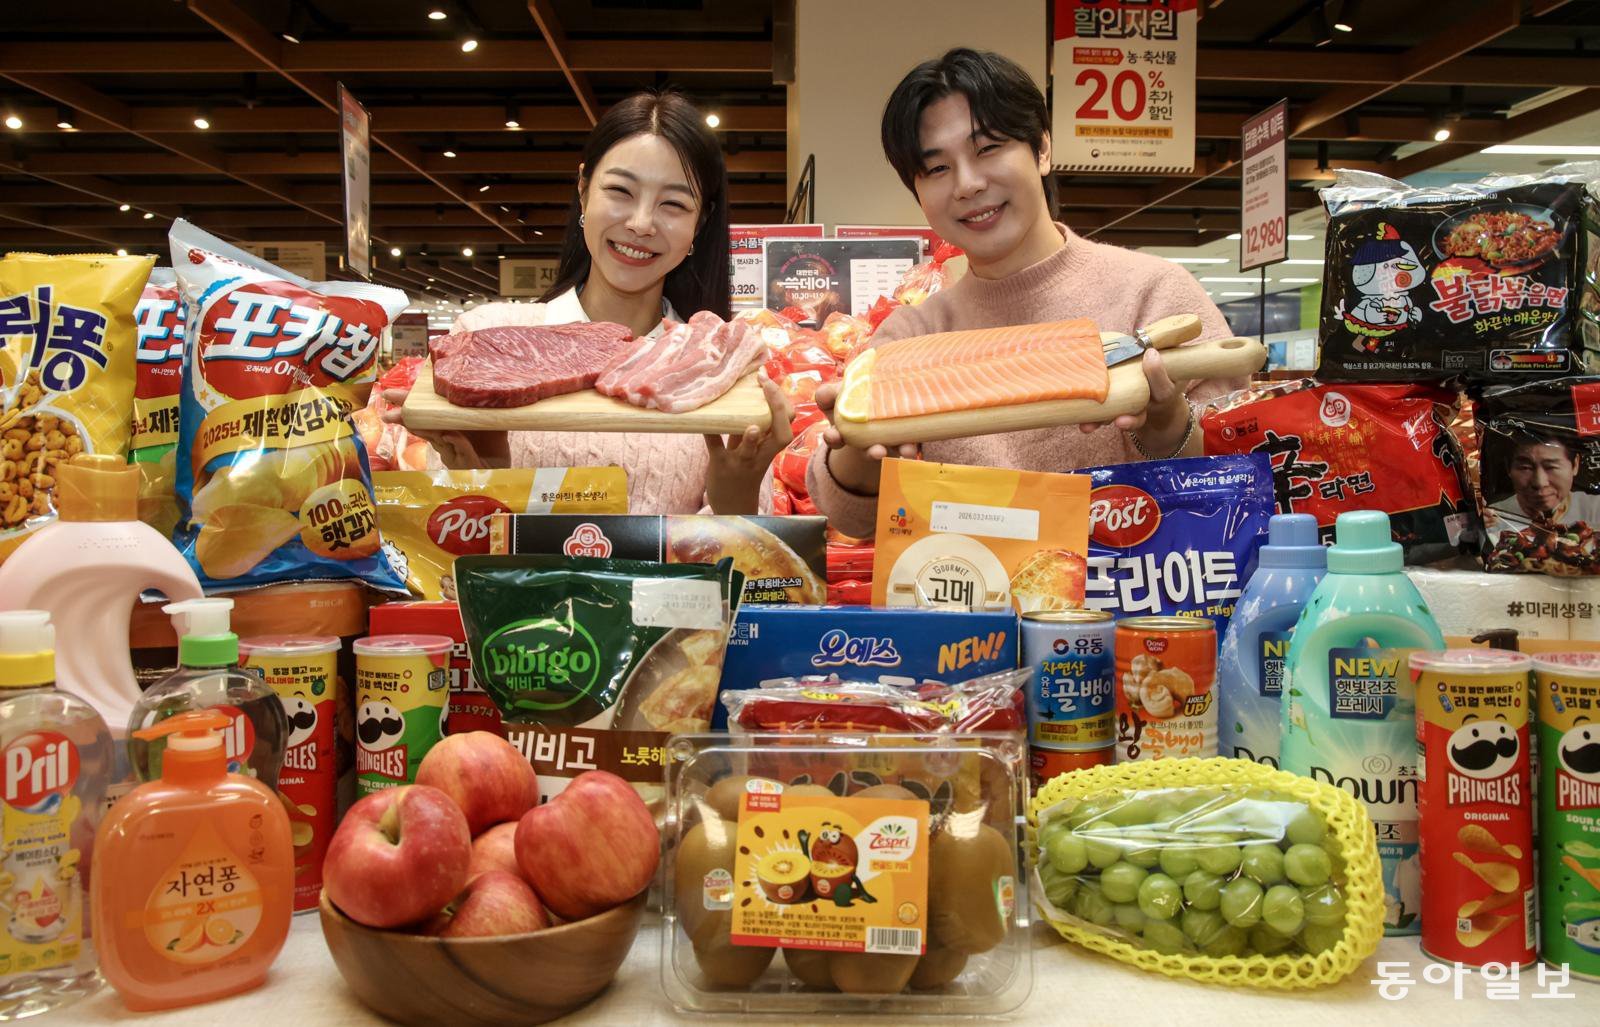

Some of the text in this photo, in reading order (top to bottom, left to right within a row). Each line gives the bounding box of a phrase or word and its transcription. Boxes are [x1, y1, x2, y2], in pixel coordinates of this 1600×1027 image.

[1073, 7, 1177, 40] 할인지원
[1127, 50, 1177, 65] 농·축산물
[1148, 90, 1173, 105] 추가
[1148, 105, 1173, 121] 할인
[1245, 216, 1285, 255] 12,980
[1430, 274, 1569, 322] 불닭볶음면
[1473, 312, 1558, 334] 화끈한 매운맛!
[203, 290, 380, 383] 포카칩
[273, 359, 316, 386] Original
[202, 419, 241, 449] 2025년
[1318, 471, 1376, 500] 라면
[306, 490, 368, 527] 100% 국산
[1089, 497, 1147, 536] Post
[320, 507, 377, 551] 햇감자
[932, 563, 970, 577] GOURMET
[927, 576, 974, 606] 고메
[1176, 609, 1204, 617] Corn
[1507, 601, 1593, 618] #미래생활
[812, 629, 901, 667] 오예스
[938, 632, 1006, 674] NEW!
[1074, 638, 1104, 655] 유동
[490, 642, 591, 683] bibigo
[1042, 661, 1086, 677] 자연산
[1335, 658, 1400, 677] NEW
[505, 676, 546, 691] 비비고
[1336, 680, 1397, 696] 햇빛건조
[1051, 677, 1116, 713] 골뱅이
[1336, 698, 1383, 713] 프레시
[1454, 695, 1512, 708] 리얼 액션!
[1565, 697, 1591, 709] 리얼
[464, 705, 494, 718] 1974
[1183, 703, 1204, 717] UP
[1118, 711, 1148, 760] 왕
[356, 747, 404, 778] PRINGLES
[620, 747, 675, 766] 노릇해
[6, 740, 69, 800] Pril
[1448, 773, 1520, 806] PRINGLES
[1559, 774, 1600, 807] PRIN
[1464, 812, 1510, 821] ORIGINAL
[1566, 814, 1594, 824] SOUR
[869, 832, 911, 850] Zespri
[166, 863, 241, 897] 자연퐁
[197, 901, 216, 915] 2X
